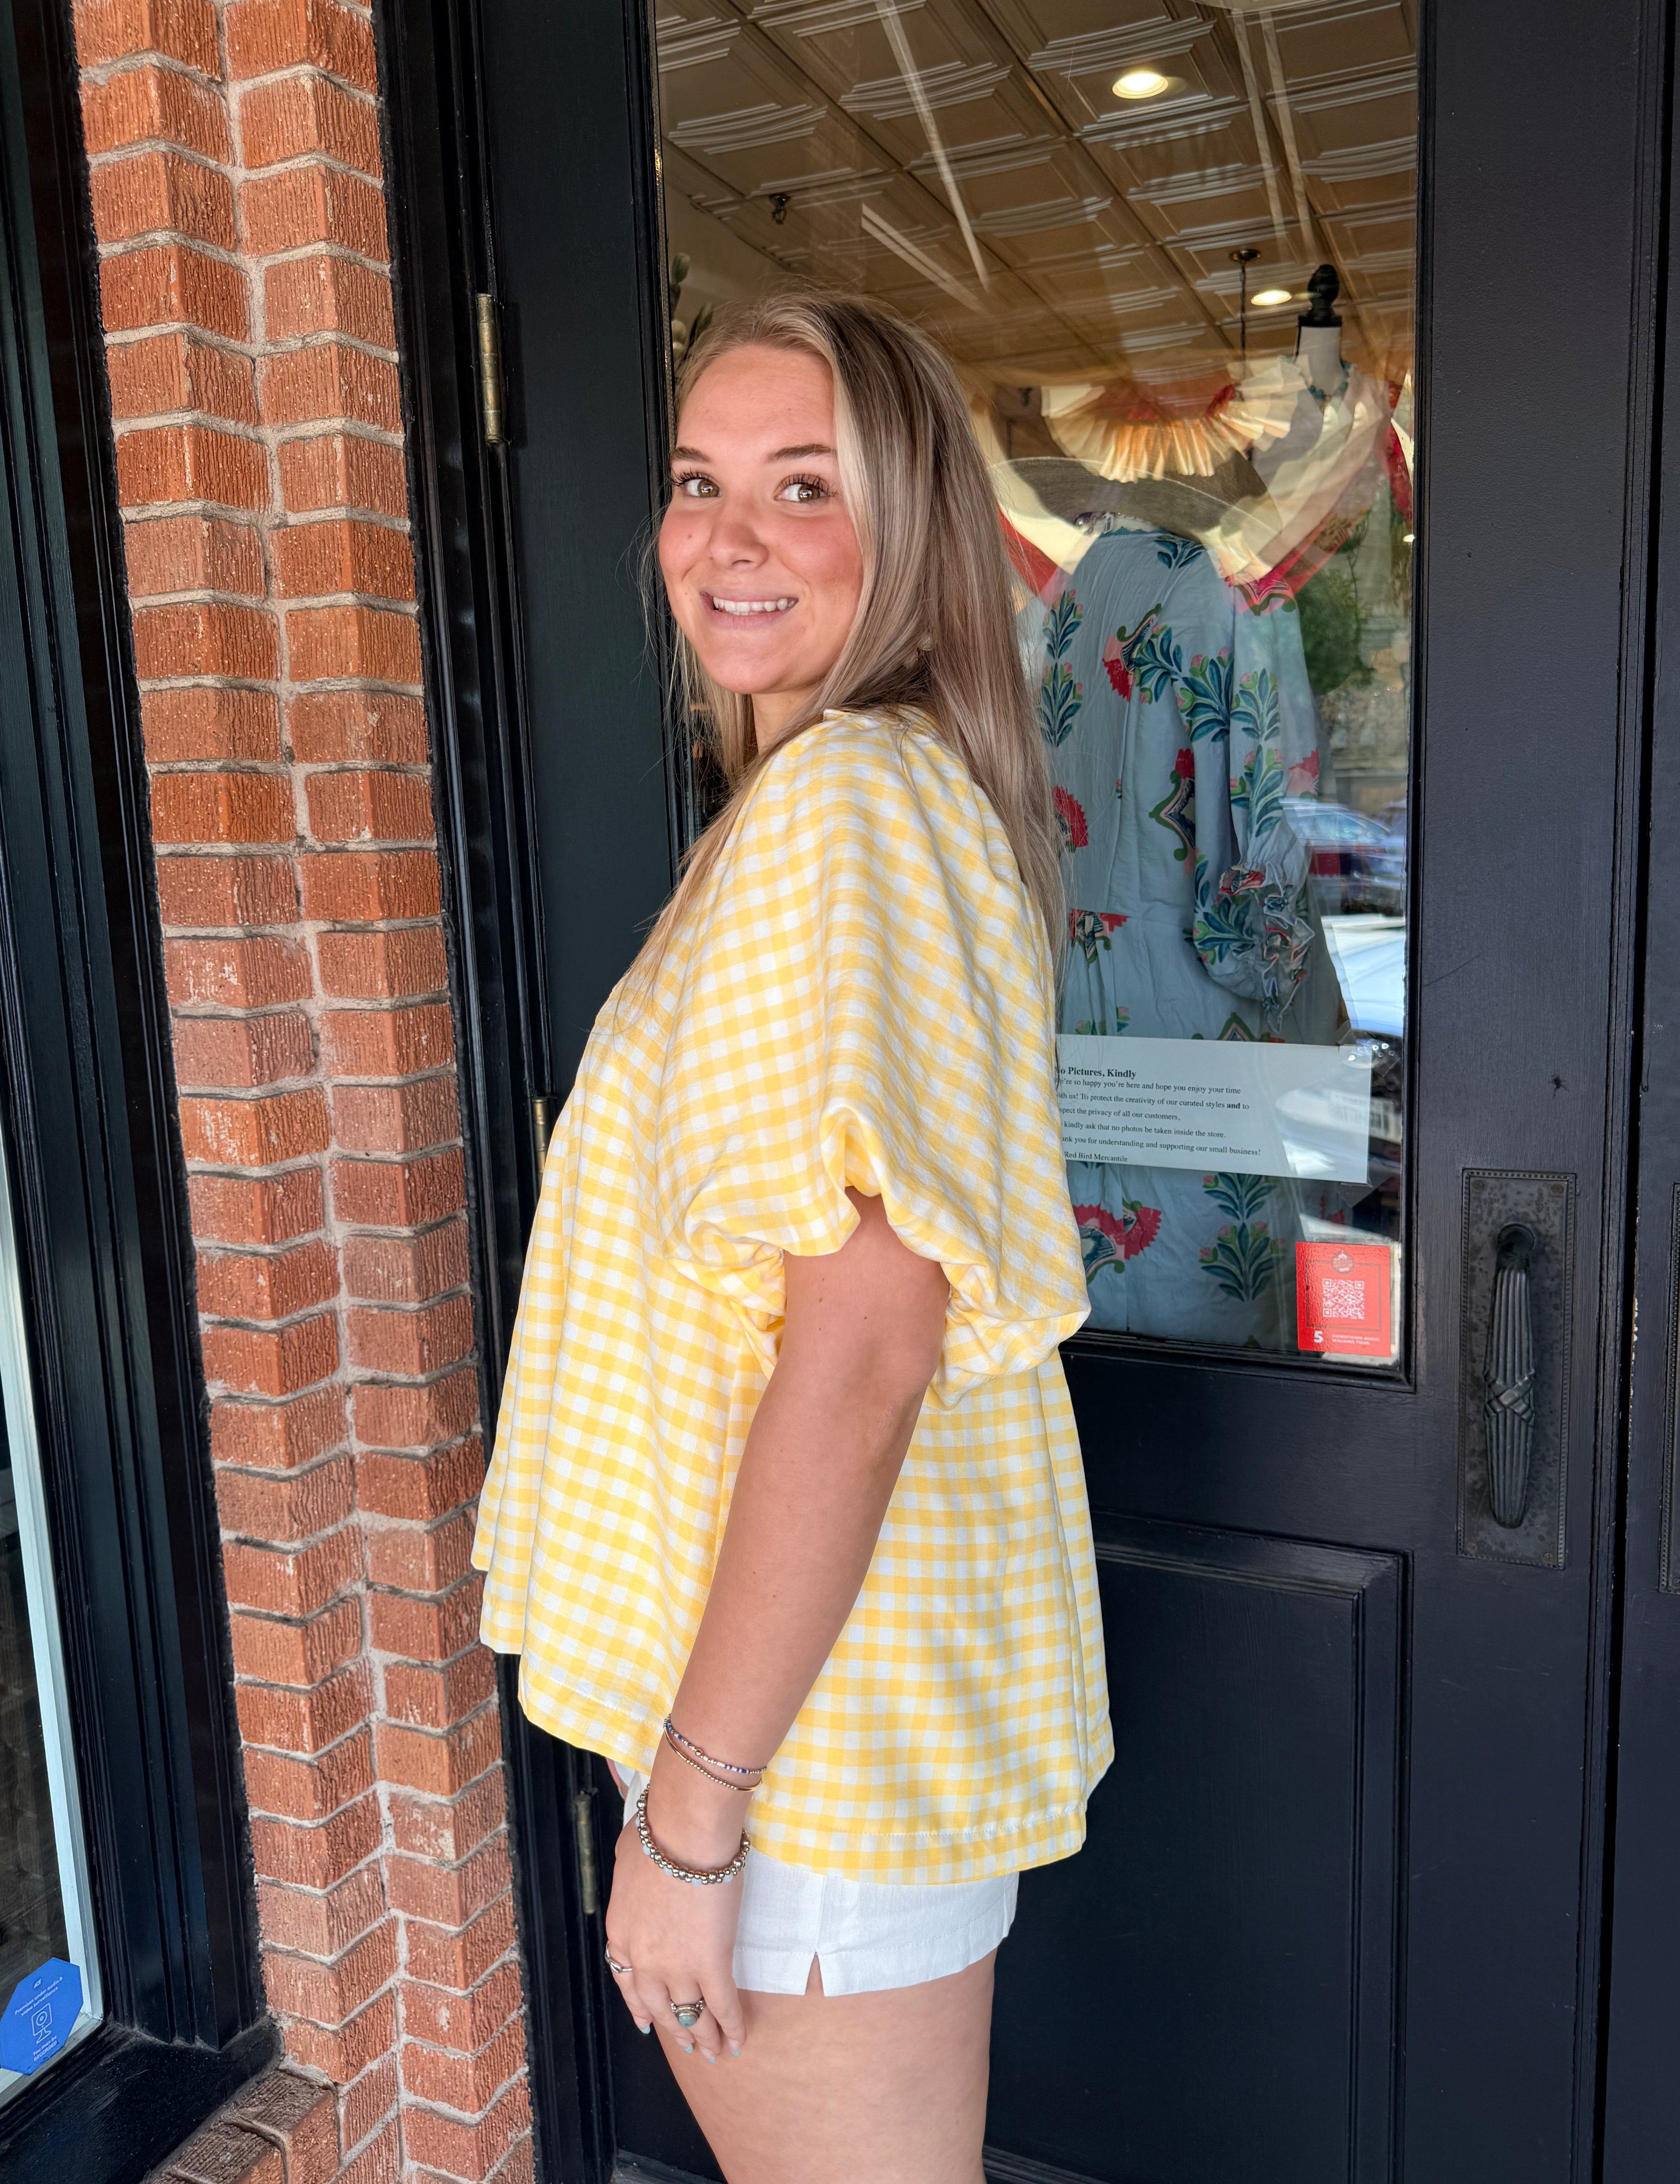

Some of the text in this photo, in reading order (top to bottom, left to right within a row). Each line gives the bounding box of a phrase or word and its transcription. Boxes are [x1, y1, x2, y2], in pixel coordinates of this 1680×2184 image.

[1068, 1067, 1105, 1077] Pictures,
[1107, 1069, 1136, 1079] Kindly
[1083, 1080, 1102, 1088] happy
[1156, 1083, 1171, 1091] hope
[1125, 1097, 1155, 1105] creativity
[1064, 1121, 1084, 1129] kindly
[1099, 1139, 1144, 1148] understanding
[1159, 1143, 1194, 1152] supporting
[1229, 1147, 1260, 1155] business!
[1094, 1154, 1128, 1162] Mercantile
[1314, 1330, 1323, 1344] 5
[34, 1979, 42, 1989] ADT
[15, 1999, 34, 2015] Premises
[35, 1989, 47, 2000] under
[47, 1980, 59, 1991] audio
[21, 1986, 58, 2016] video surveillance
[41, 2040, 51, 2049] may
[34, 2040, 57, 2062] RECORDED
